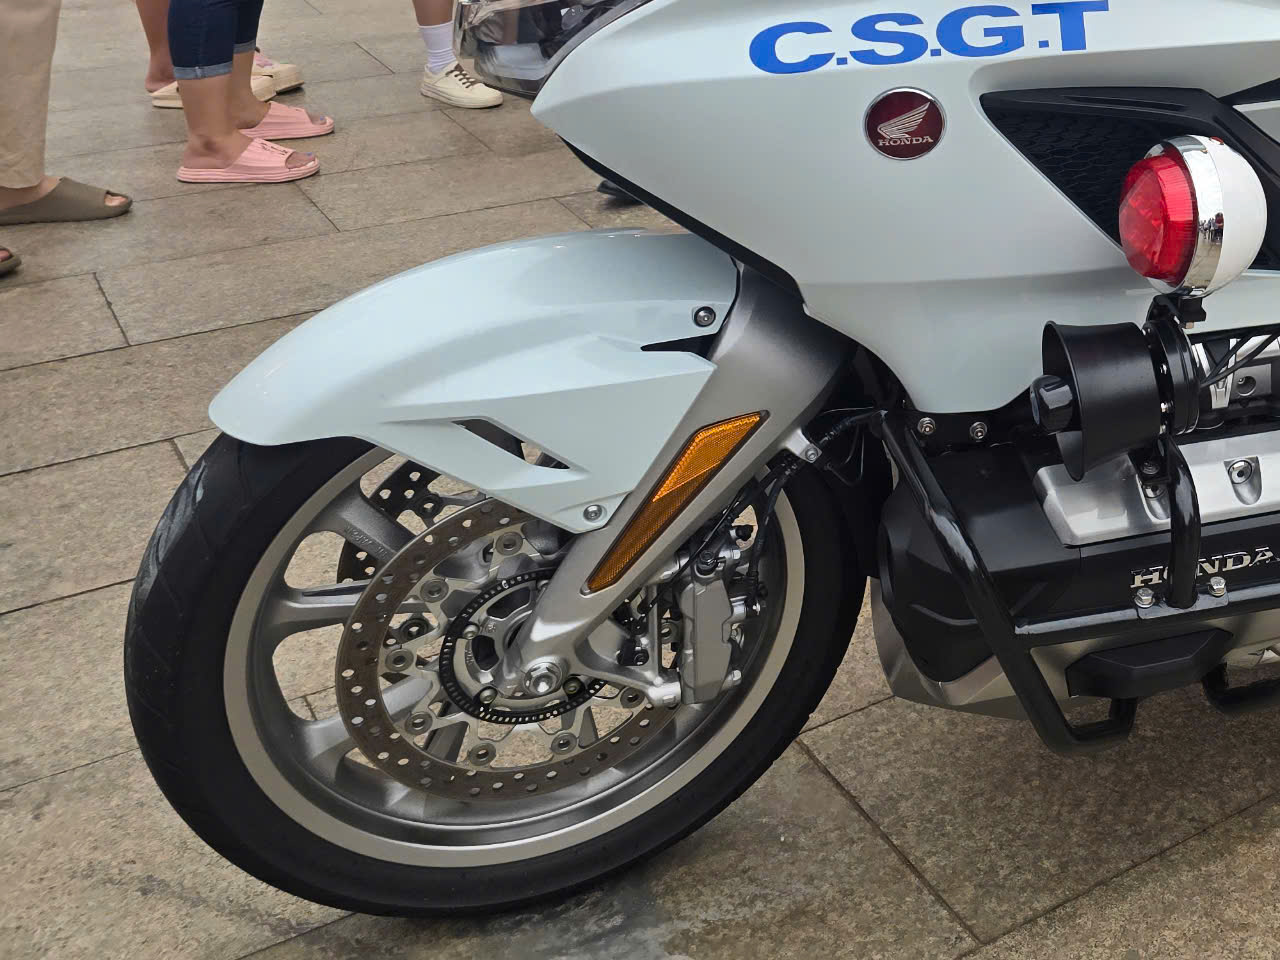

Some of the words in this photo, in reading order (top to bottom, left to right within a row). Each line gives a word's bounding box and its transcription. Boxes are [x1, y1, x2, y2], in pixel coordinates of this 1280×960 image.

[749, 0, 1109, 74] C.S.G.T
[877, 135, 934, 146] HONDA
[1130, 546, 1280, 588] HNDA
